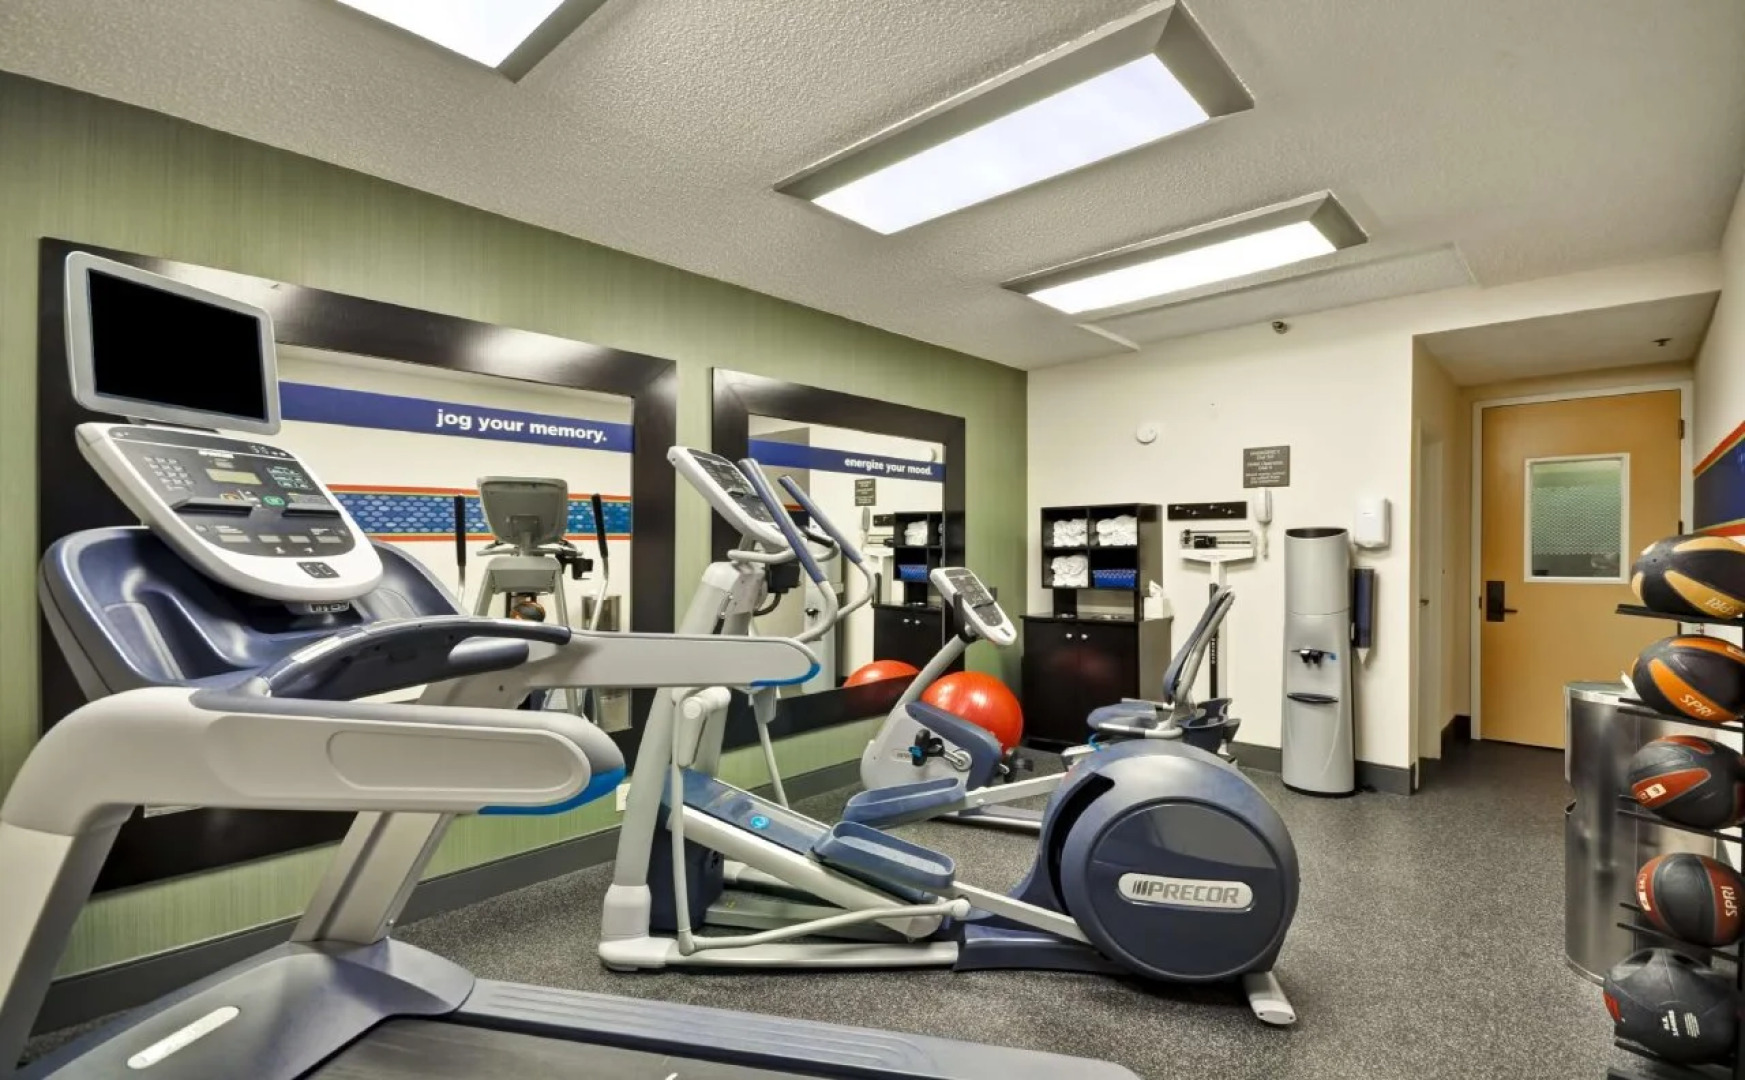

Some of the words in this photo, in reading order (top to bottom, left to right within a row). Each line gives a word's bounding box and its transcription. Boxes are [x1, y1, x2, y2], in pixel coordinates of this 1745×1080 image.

[436, 408, 472, 430] jog
[478, 416, 524, 432] your
[529, 423, 608, 443] memory.
[844, 458, 884, 471] energize
[885, 463, 906, 474] your
[907, 465, 933, 476] mood.
[1679, 694, 1717, 717] SPRI
[1149, 881, 1240, 904] PRECOR
[1720, 885, 1738, 917] SPRI
